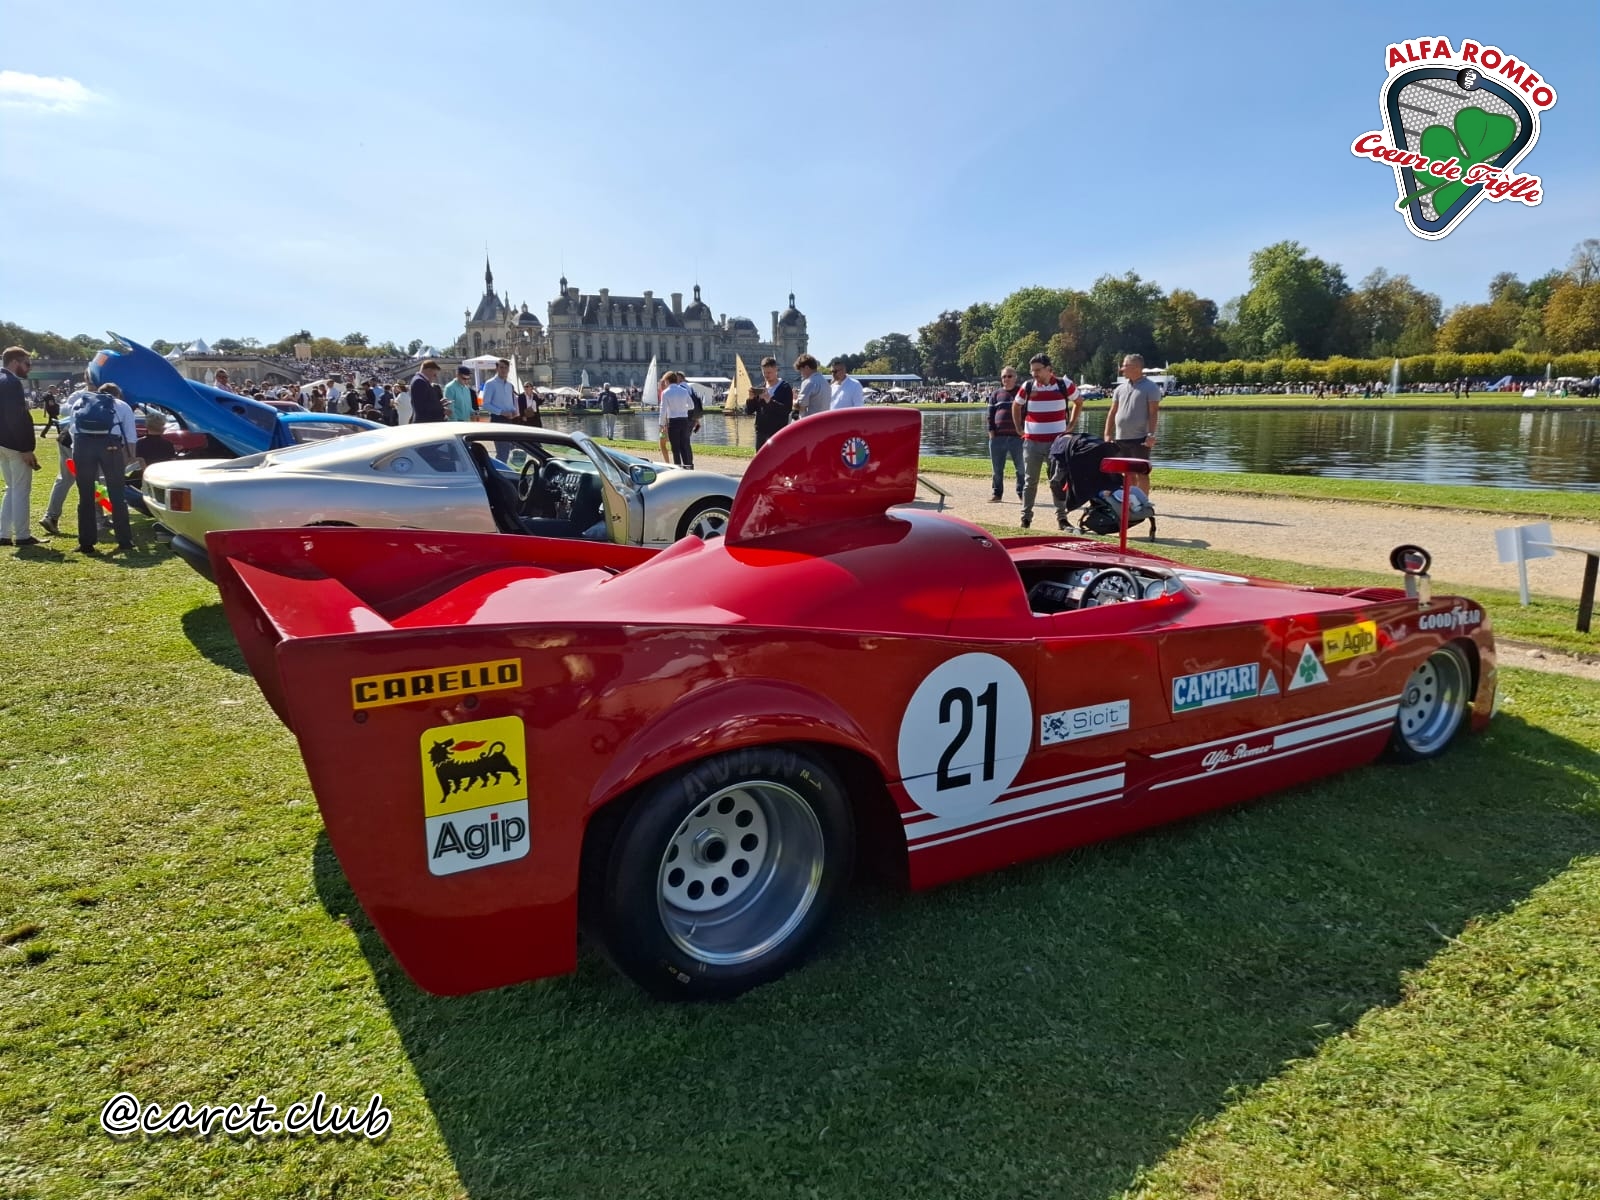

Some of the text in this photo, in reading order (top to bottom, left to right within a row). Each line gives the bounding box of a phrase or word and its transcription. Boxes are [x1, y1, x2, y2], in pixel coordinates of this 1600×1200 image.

[1342, 627, 1374, 654] Agip
[354, 662, 519, 704] CARELLO
[1174, 664, 1258, 706] CAMPARI
[936, 681, 998, 793] 21
[1073, 707, 1119, 729] Sicit
[1201, 747, 1232, 772] Alfa
[432, 812, 526, 861] Agip
